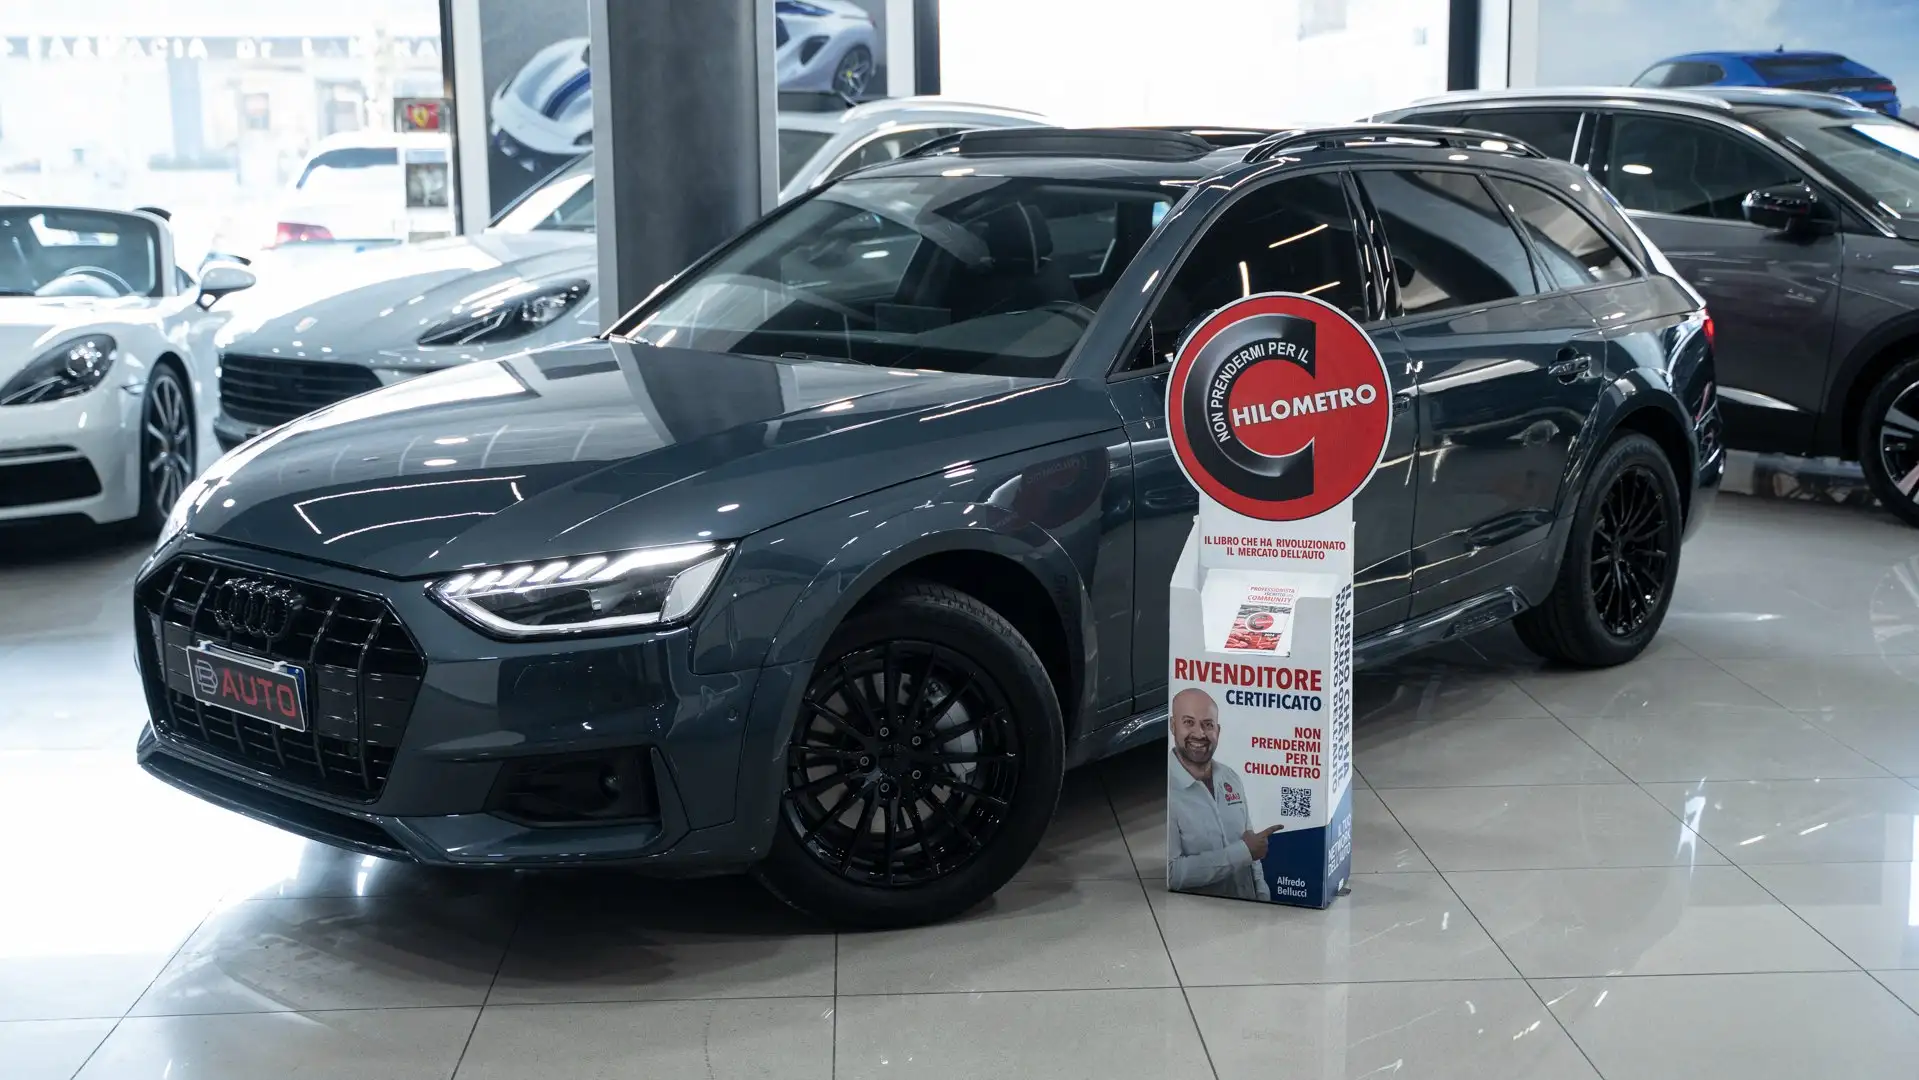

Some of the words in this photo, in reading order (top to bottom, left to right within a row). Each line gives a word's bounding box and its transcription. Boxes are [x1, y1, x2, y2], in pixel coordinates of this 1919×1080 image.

[1268, 341, 1296, 357] PER
[1297, 347, 1309, 364] IL
[1211, 343, 1265, 408] PRENDERMI
[1211, 412, 1231, 443] NON
[1204, 535, 1212, 545] IL
[1213, 536, 1239, 546] LIBRO
[1241, 537, 1258, 547] CHE
[1260, 537, 1272, 547] HA
[1276, 538, 1346, 551] RIVOLUZIONATO
[1226, 546, 1234, 556] IL
[1238, 547, 1279, 558] MERCATO
[1280, 549, 1325, 560] DELL'AUTO
[1248, 595, 1293, 603] COMMUNITY
[1175, 658, 1322, 691] RIVENDITORE
[222, 668, 297, 718] AUTO
[1226, 690, 1322, 712] CERTIFICATO
[1294, 727, 1321, 740] NON
[1251, 737, 1321, 753] PRENDERMI
[1286, 753, 1308, 765] PER
[1311, 754, 1321, 766] IL
[1244, 762, 1321, 779] CHILOMETRO
[1276, 876, 1306, 887] Alfredo
[1277, 886, 1307, 897] Bellucci
